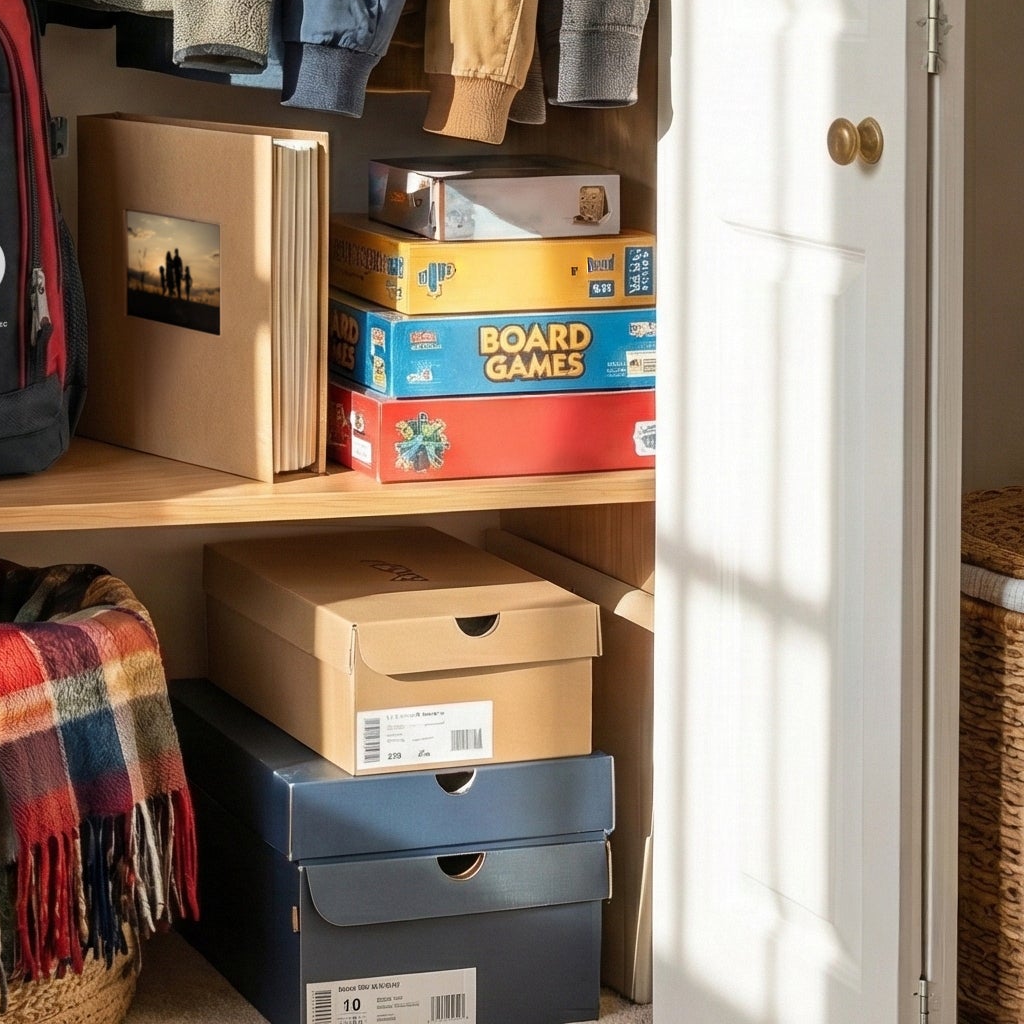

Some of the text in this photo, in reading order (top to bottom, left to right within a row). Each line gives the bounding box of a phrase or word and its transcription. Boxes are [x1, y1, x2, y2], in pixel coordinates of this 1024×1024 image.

[479, 323, 592, 352] BOARD
[485, 352, 585, 380] GAMES
[343, 998, 361, 1012] 10
